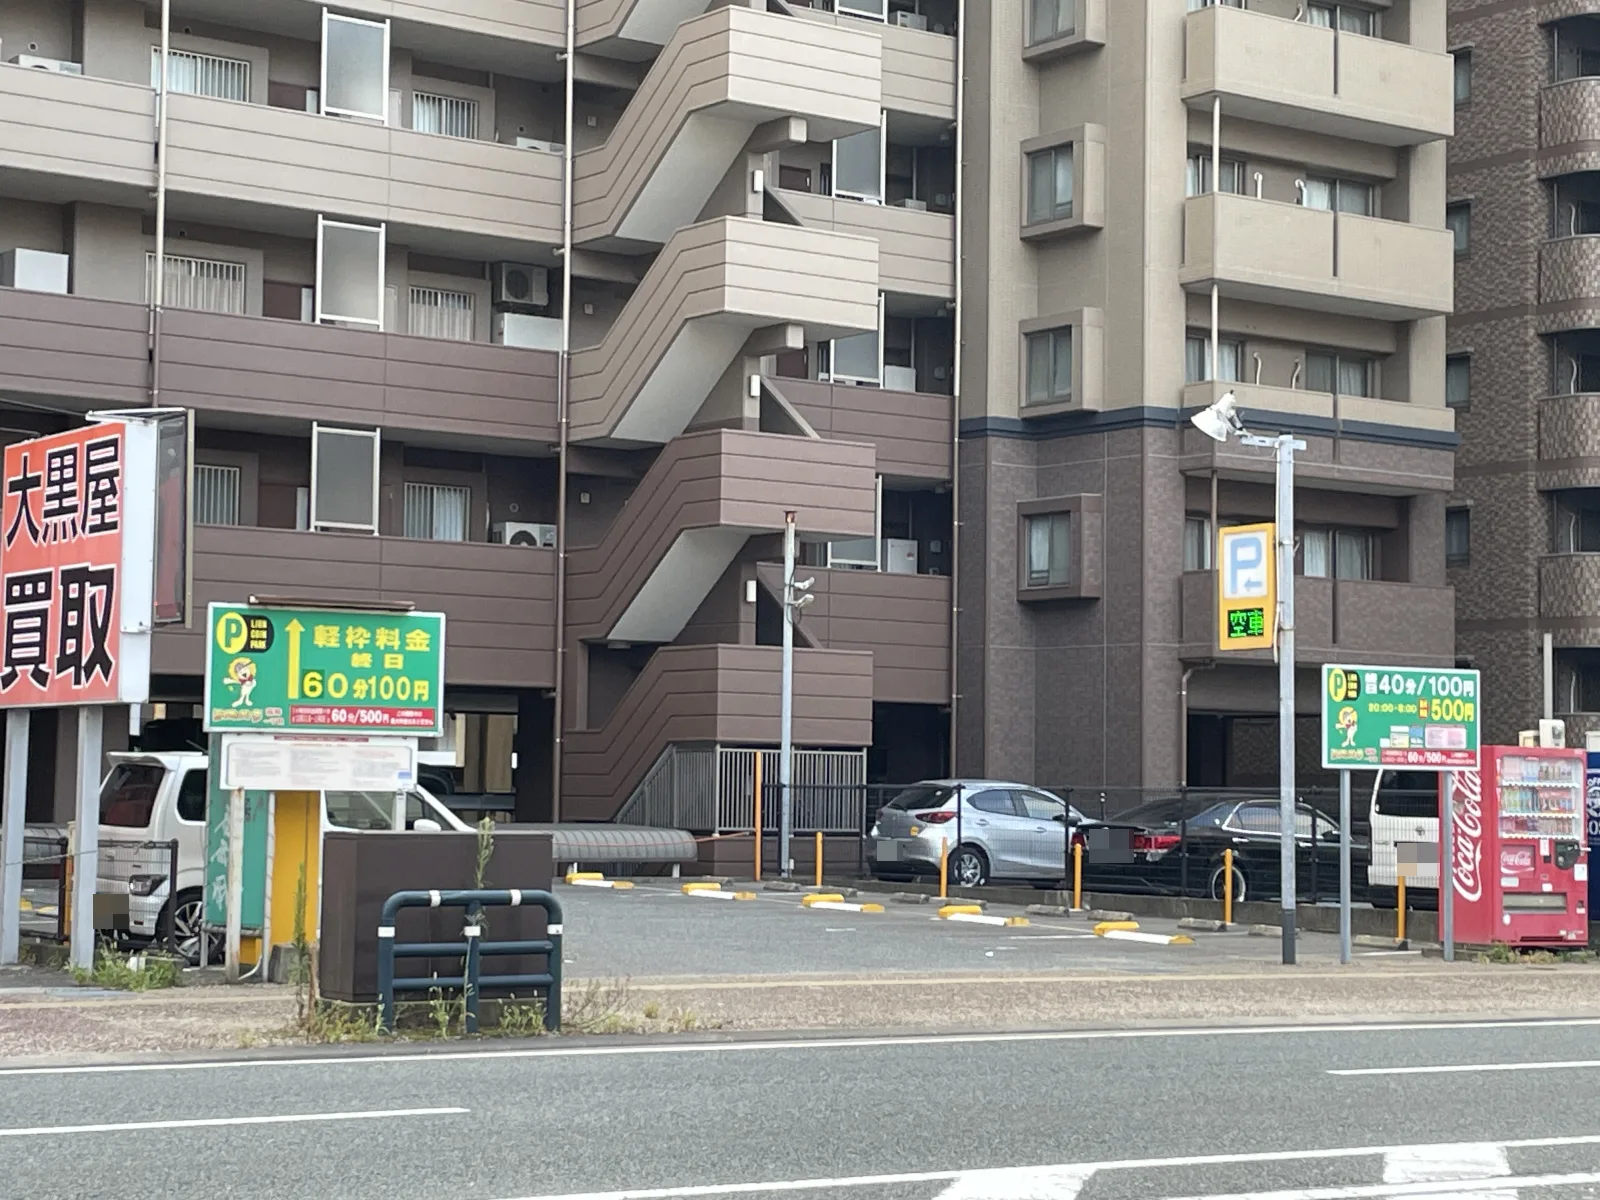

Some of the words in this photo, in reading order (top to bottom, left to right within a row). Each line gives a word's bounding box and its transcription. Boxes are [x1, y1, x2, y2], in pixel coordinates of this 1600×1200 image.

[6, 437, 120, 548] 大黒屋
[1230, 537, 1262, 594] P
[0, 566, 116, 690] 買取
[224, 617, 242, 648] P
[314, 625, 431, 651] 軽枠料金
[1230, 610, 1263, 637] 空車
[302, 671, 429, 702] 60分100円
